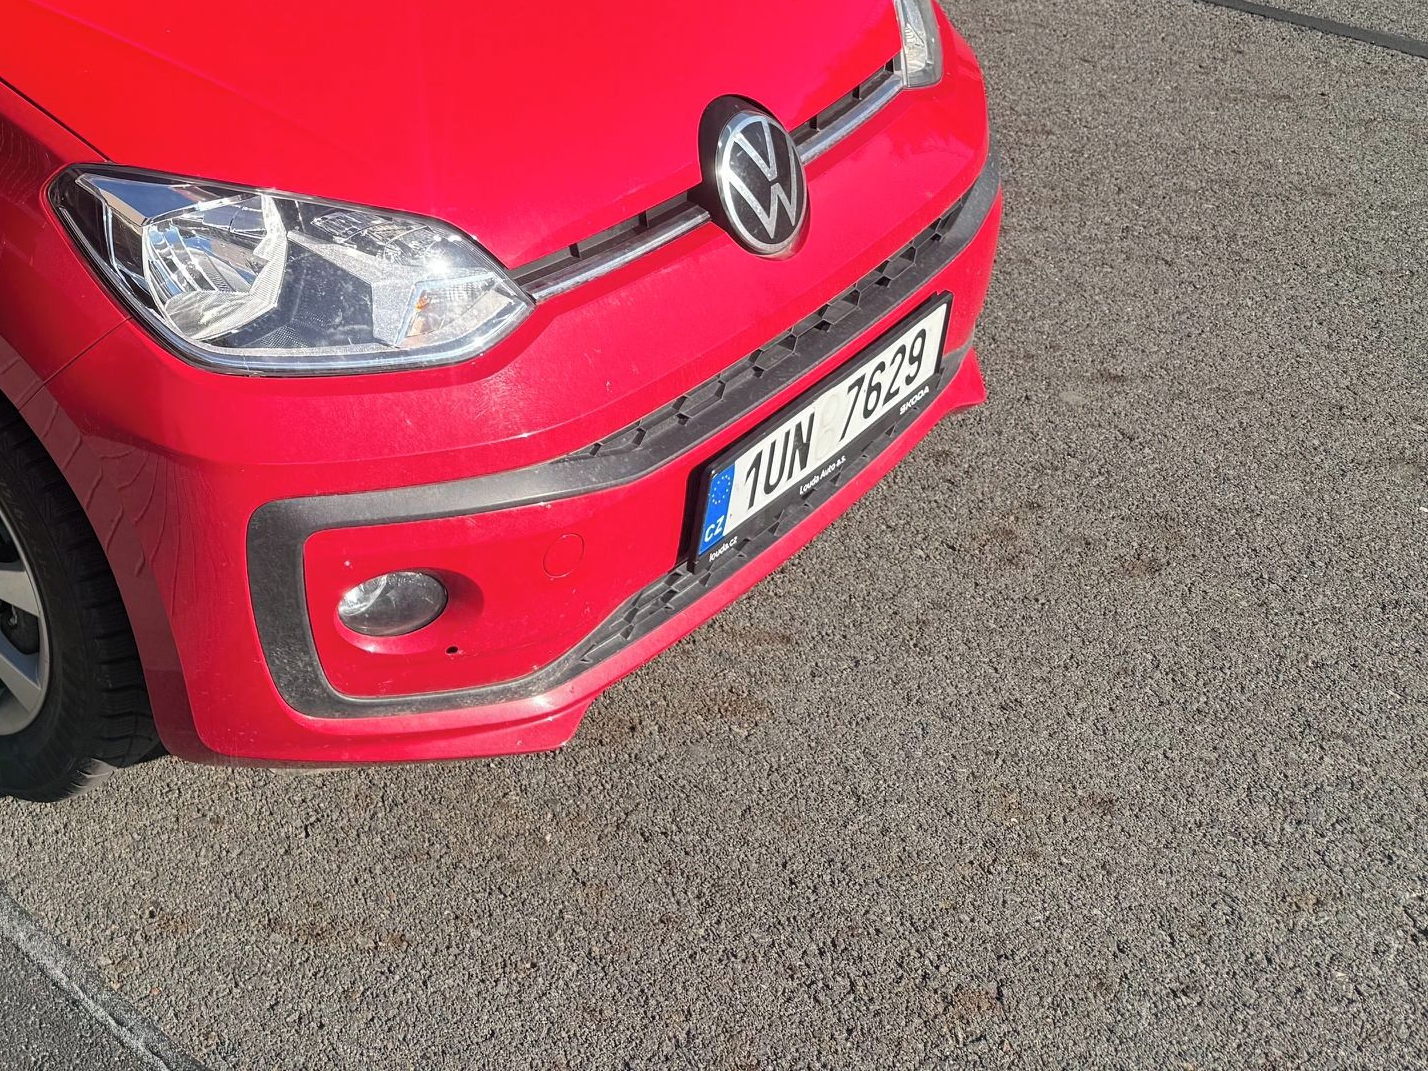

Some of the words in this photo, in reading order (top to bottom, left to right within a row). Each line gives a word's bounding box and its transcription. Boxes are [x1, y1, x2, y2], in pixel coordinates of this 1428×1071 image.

[745, 412, 814, 510] 1UN
[838, 328, 926, 442] 7629
[799, 475, 820, 495] Louda
[819, 463, 836, 480] Auto
[704, 515, 725, 542] CZ
[709, 536, 738, 562] louda.cz
